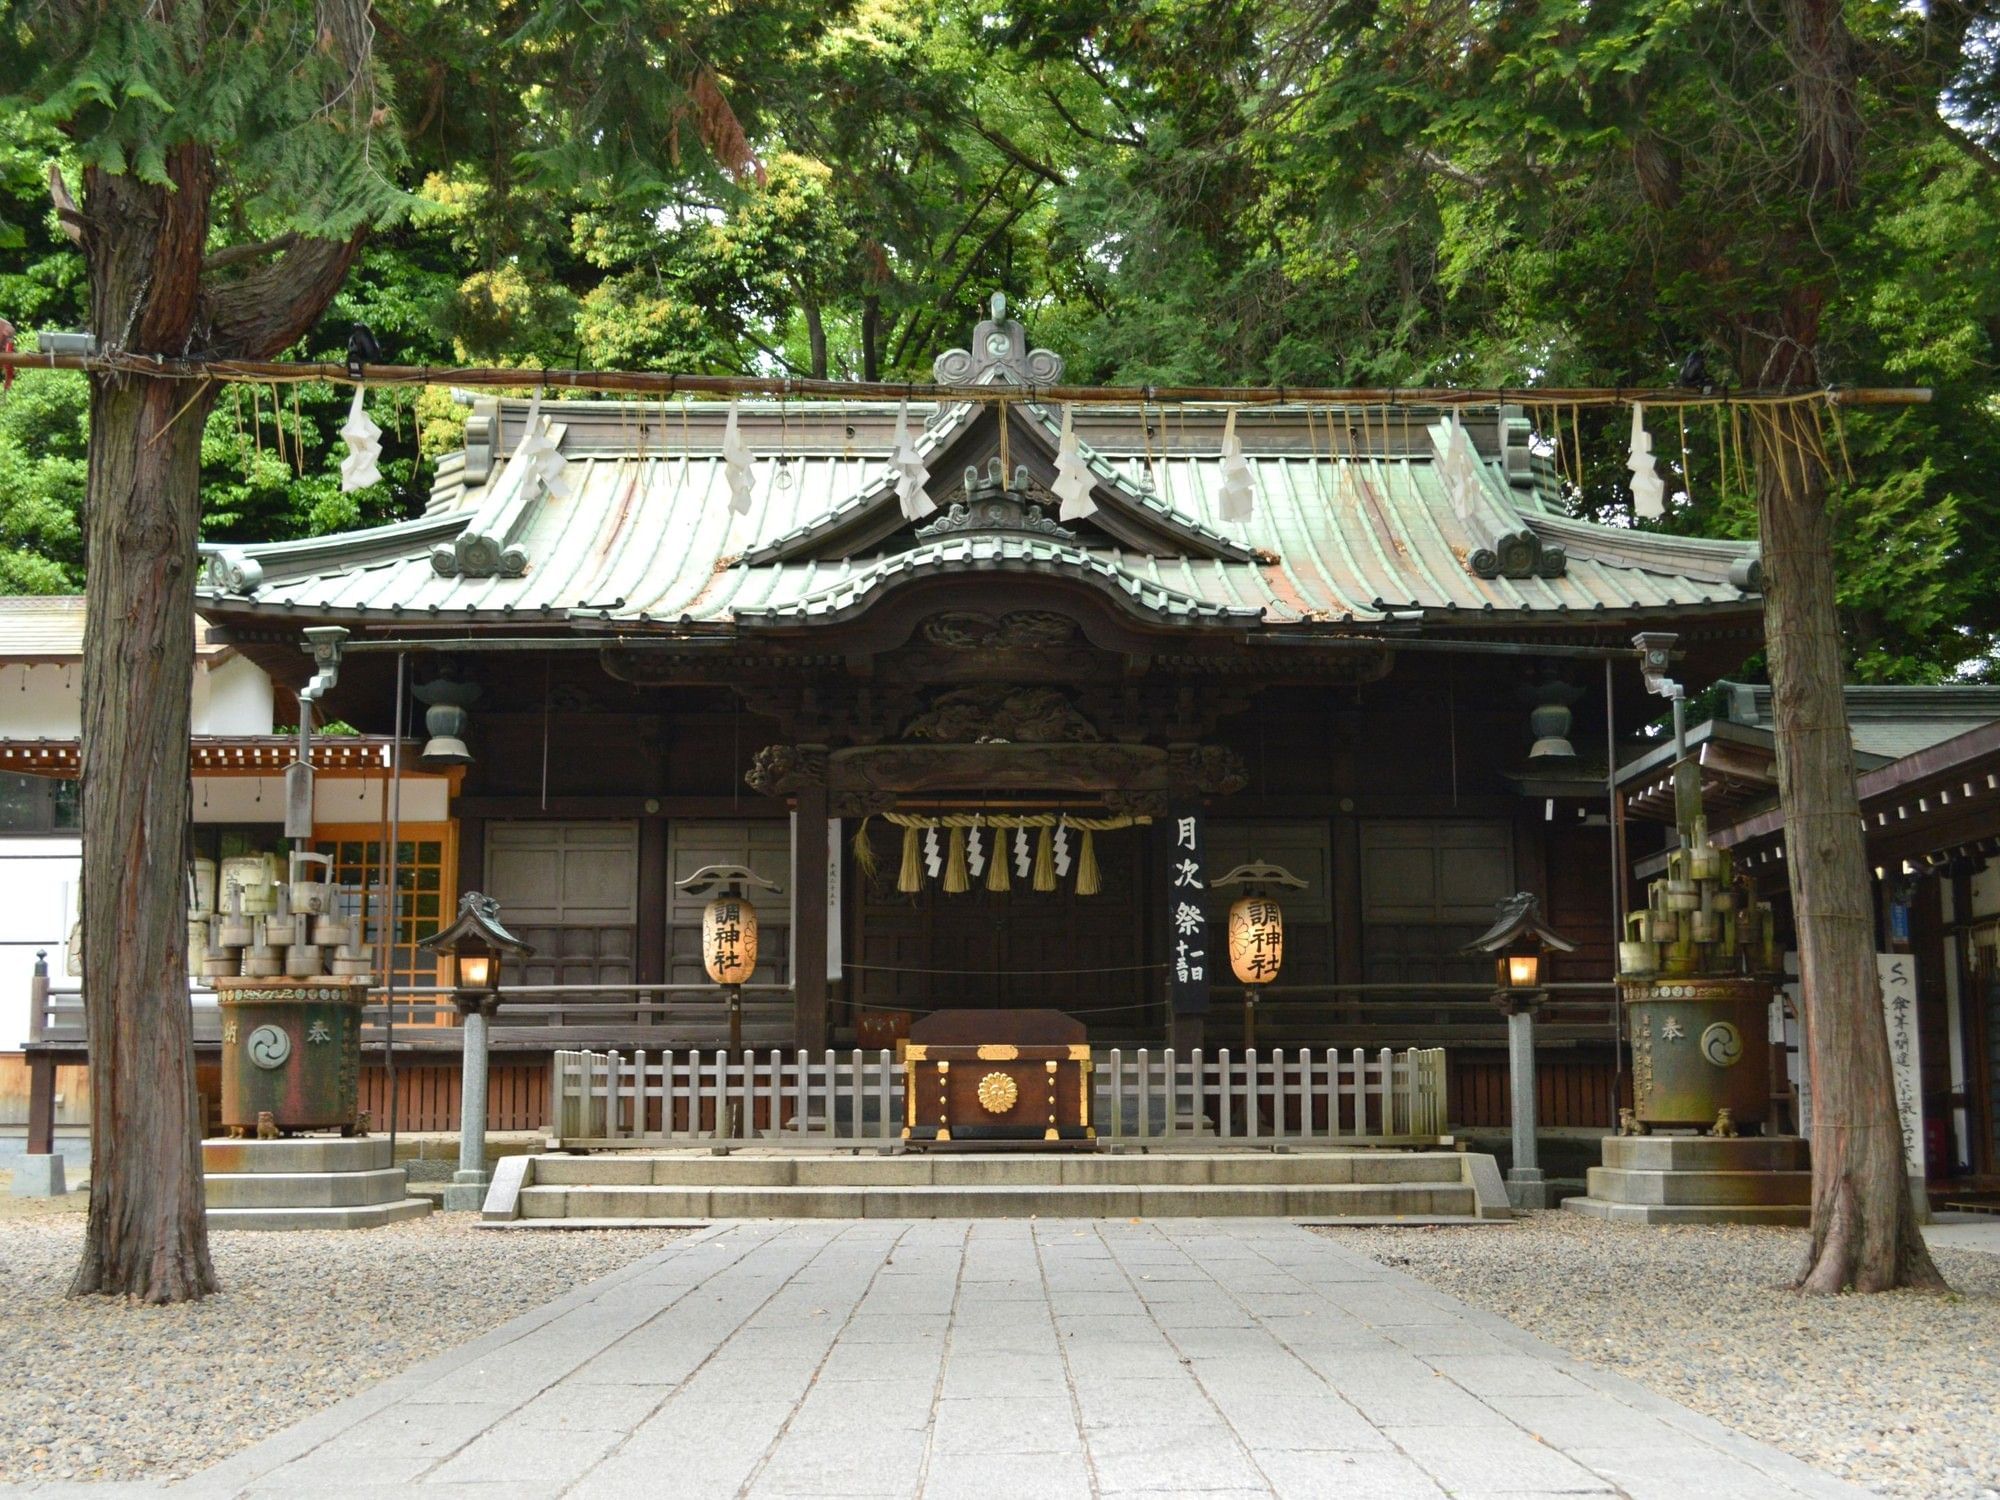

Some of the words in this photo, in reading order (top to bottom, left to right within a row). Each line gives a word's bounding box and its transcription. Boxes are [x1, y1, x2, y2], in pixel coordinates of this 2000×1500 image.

[1174, 816, 1205, 936] 月次祭
[714, 903, 741, 975] 調神社
[1248, 902, 1282, 979] 調神社
[1190, 950, 1205, 981] 一日
[307, 1020, 330, 1045] 奉
[1661, 1016, 1685, 1042] 奉
